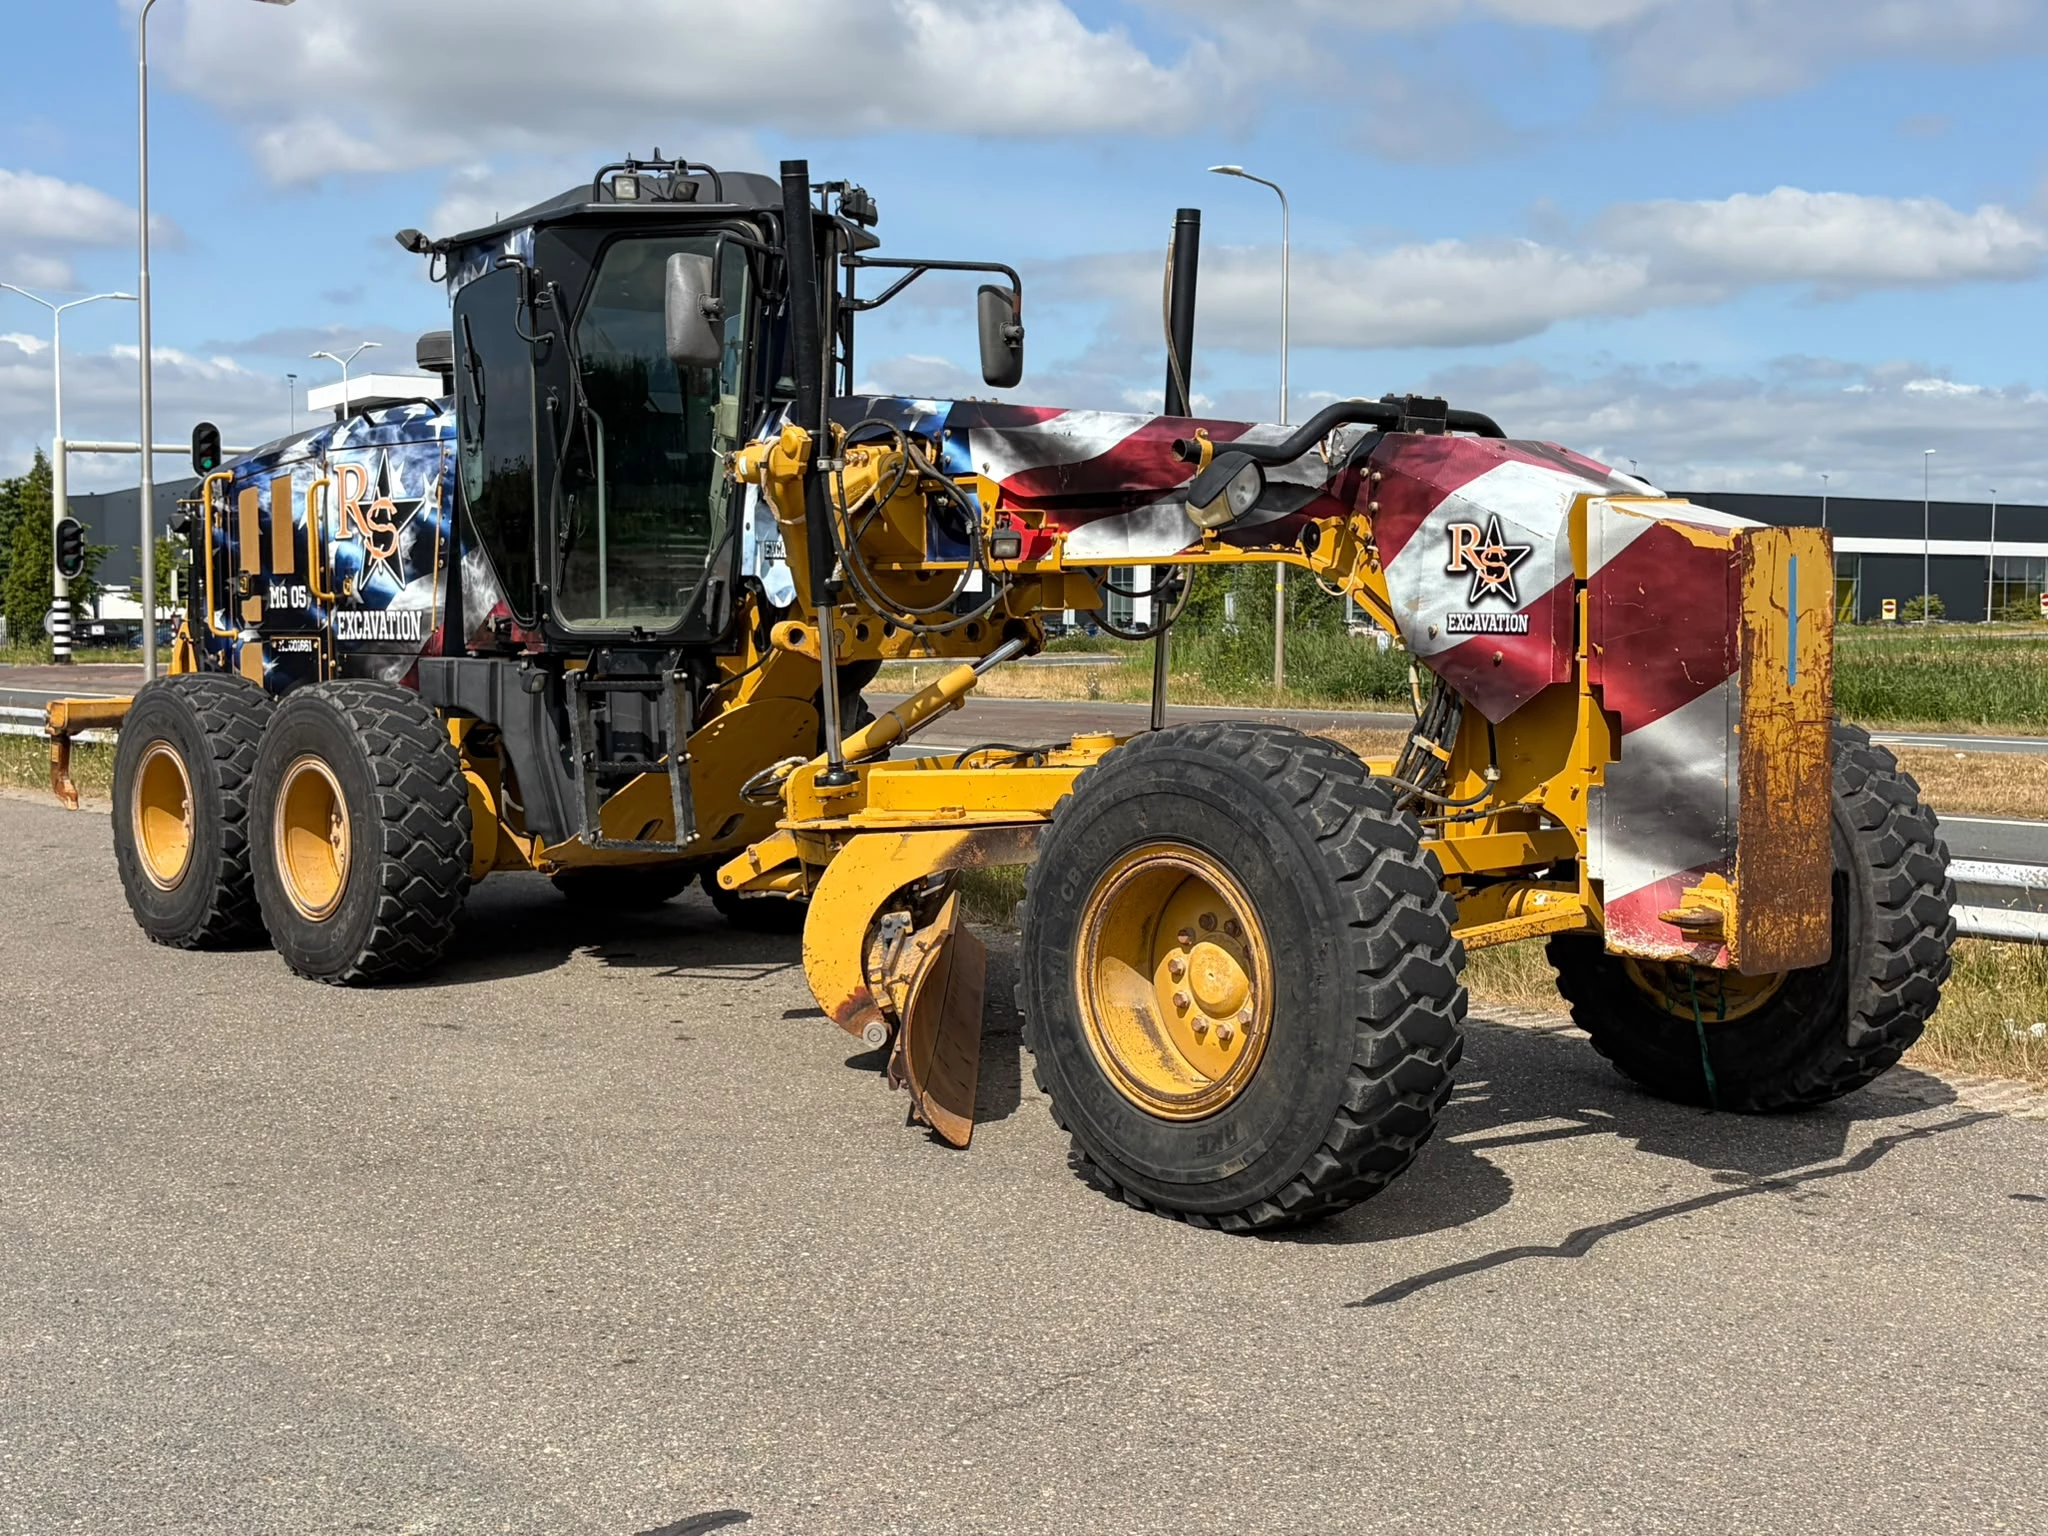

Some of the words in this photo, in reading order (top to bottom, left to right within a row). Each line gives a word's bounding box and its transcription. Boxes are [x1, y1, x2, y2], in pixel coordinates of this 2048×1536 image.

[269, 585, 288, 608] MG
[290, 585, 307, 608] 05
[336, 611, 422, 641] EXCAVATION
[1447, 613, 1529, 633] EXCAVATION
